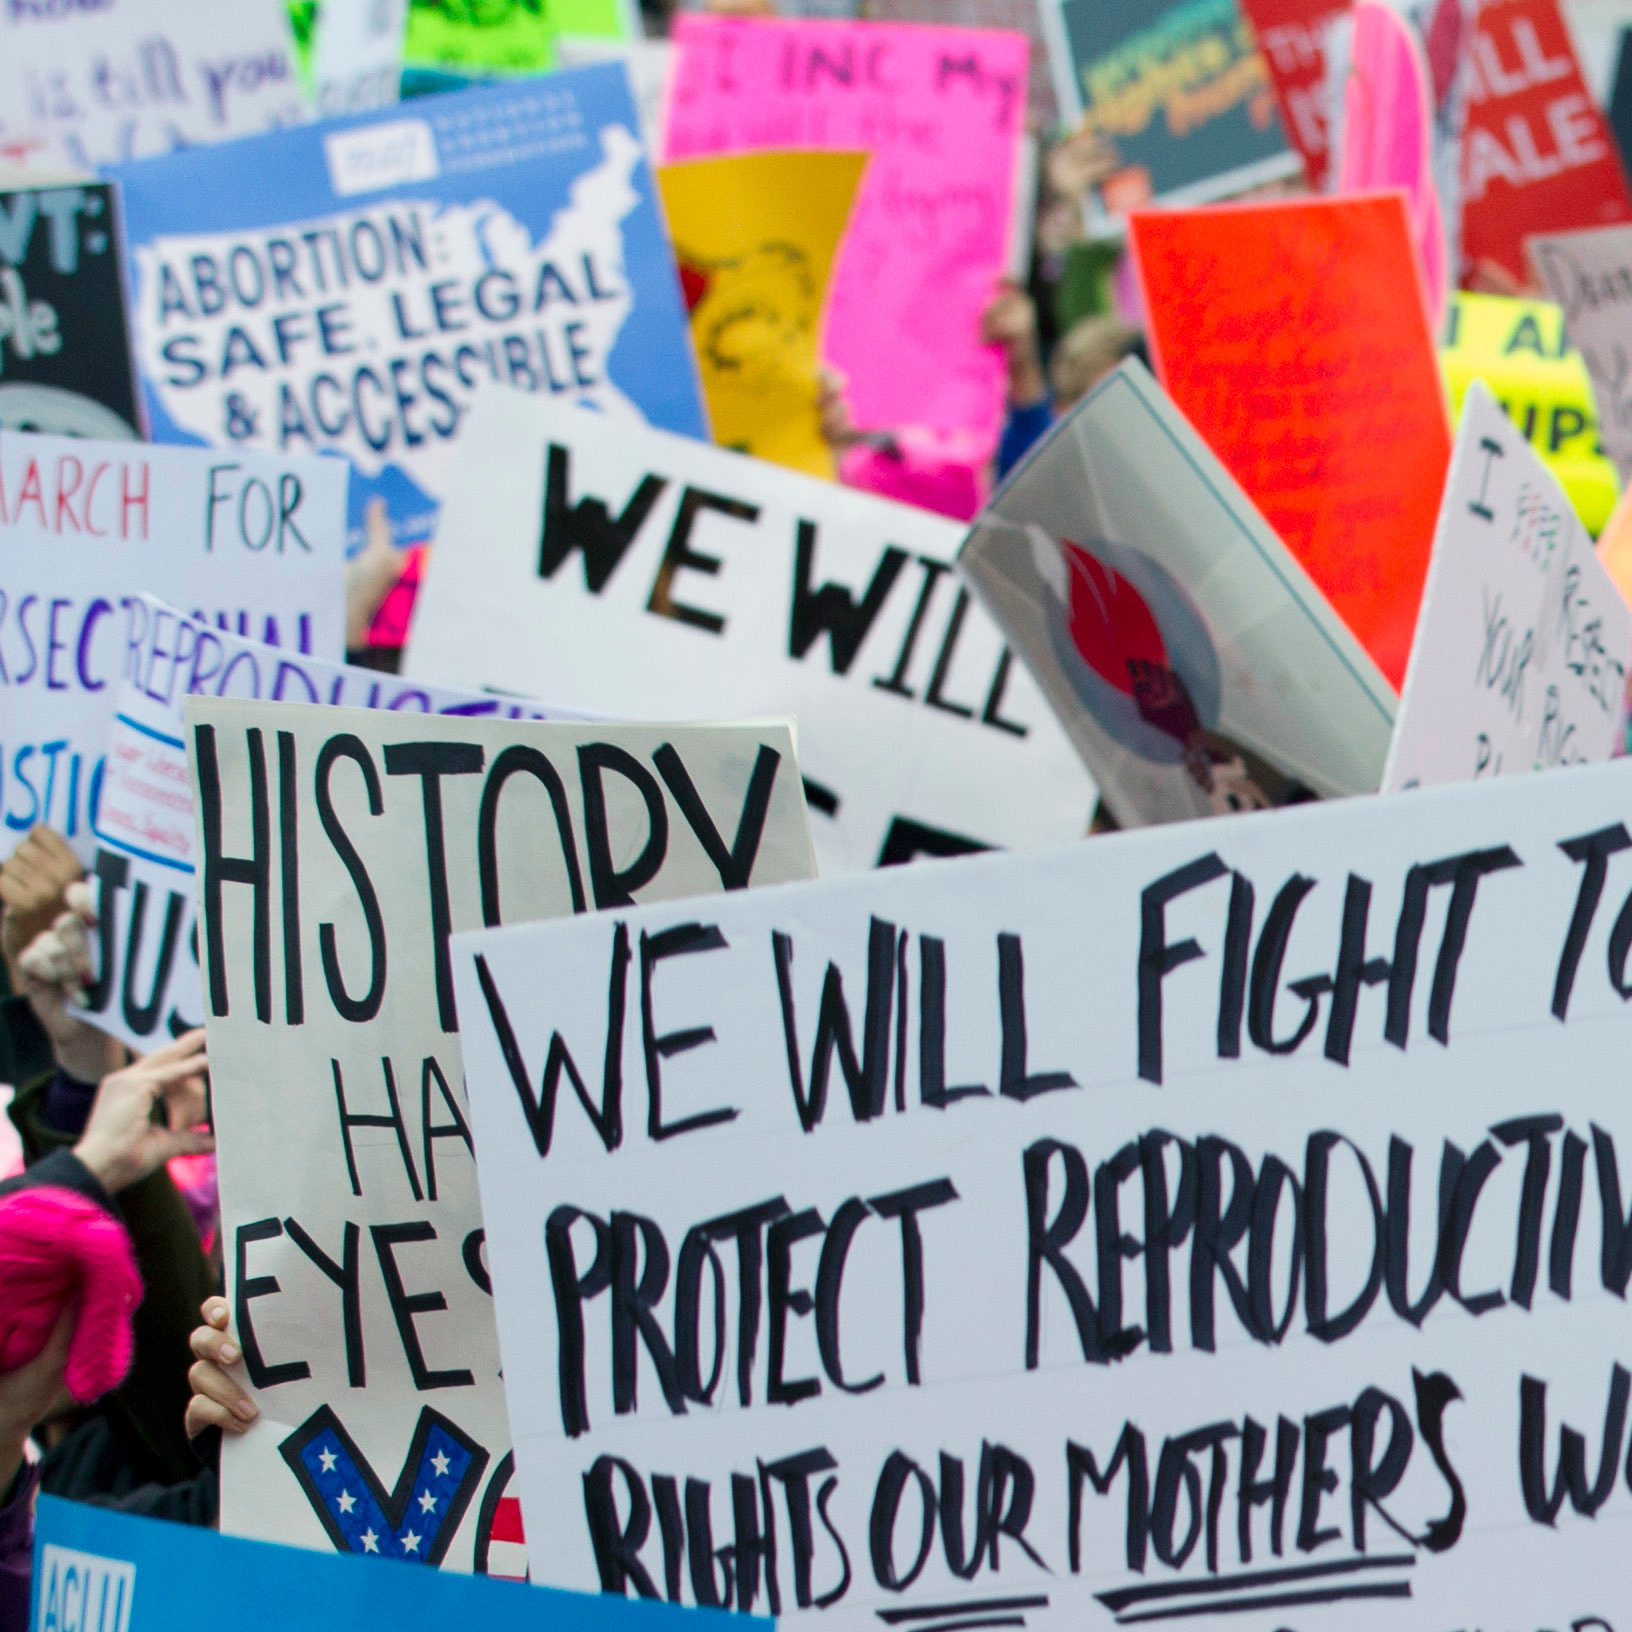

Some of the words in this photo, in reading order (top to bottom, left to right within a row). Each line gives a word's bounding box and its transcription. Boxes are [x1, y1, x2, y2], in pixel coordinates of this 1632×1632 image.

[158, 210, 448, 328] ABORTION:
[400, 250, 620, 338] LEGAL
[224, 393, 261, 443] &
[0, 456, 150, 541] ARCH
[204, 463, 313, 554] FOR
[536, 441, 761, 637] WE
[787, 515, 1031, 741] WILL
[194, 724, 781, 1034] HISTORY
[474, 921, 742, 1158] WE
[772, 914, 1080, 1133] WILL
[1137, 851, 1524, 1087] FIGHT
[331, 1054, 478, 1202] HA
[544, 1176, 962, 1439] PROTECT
[581, 1445, 852, 1616] RIGHTS
[869, 1436, 1054, 1594] OUR
